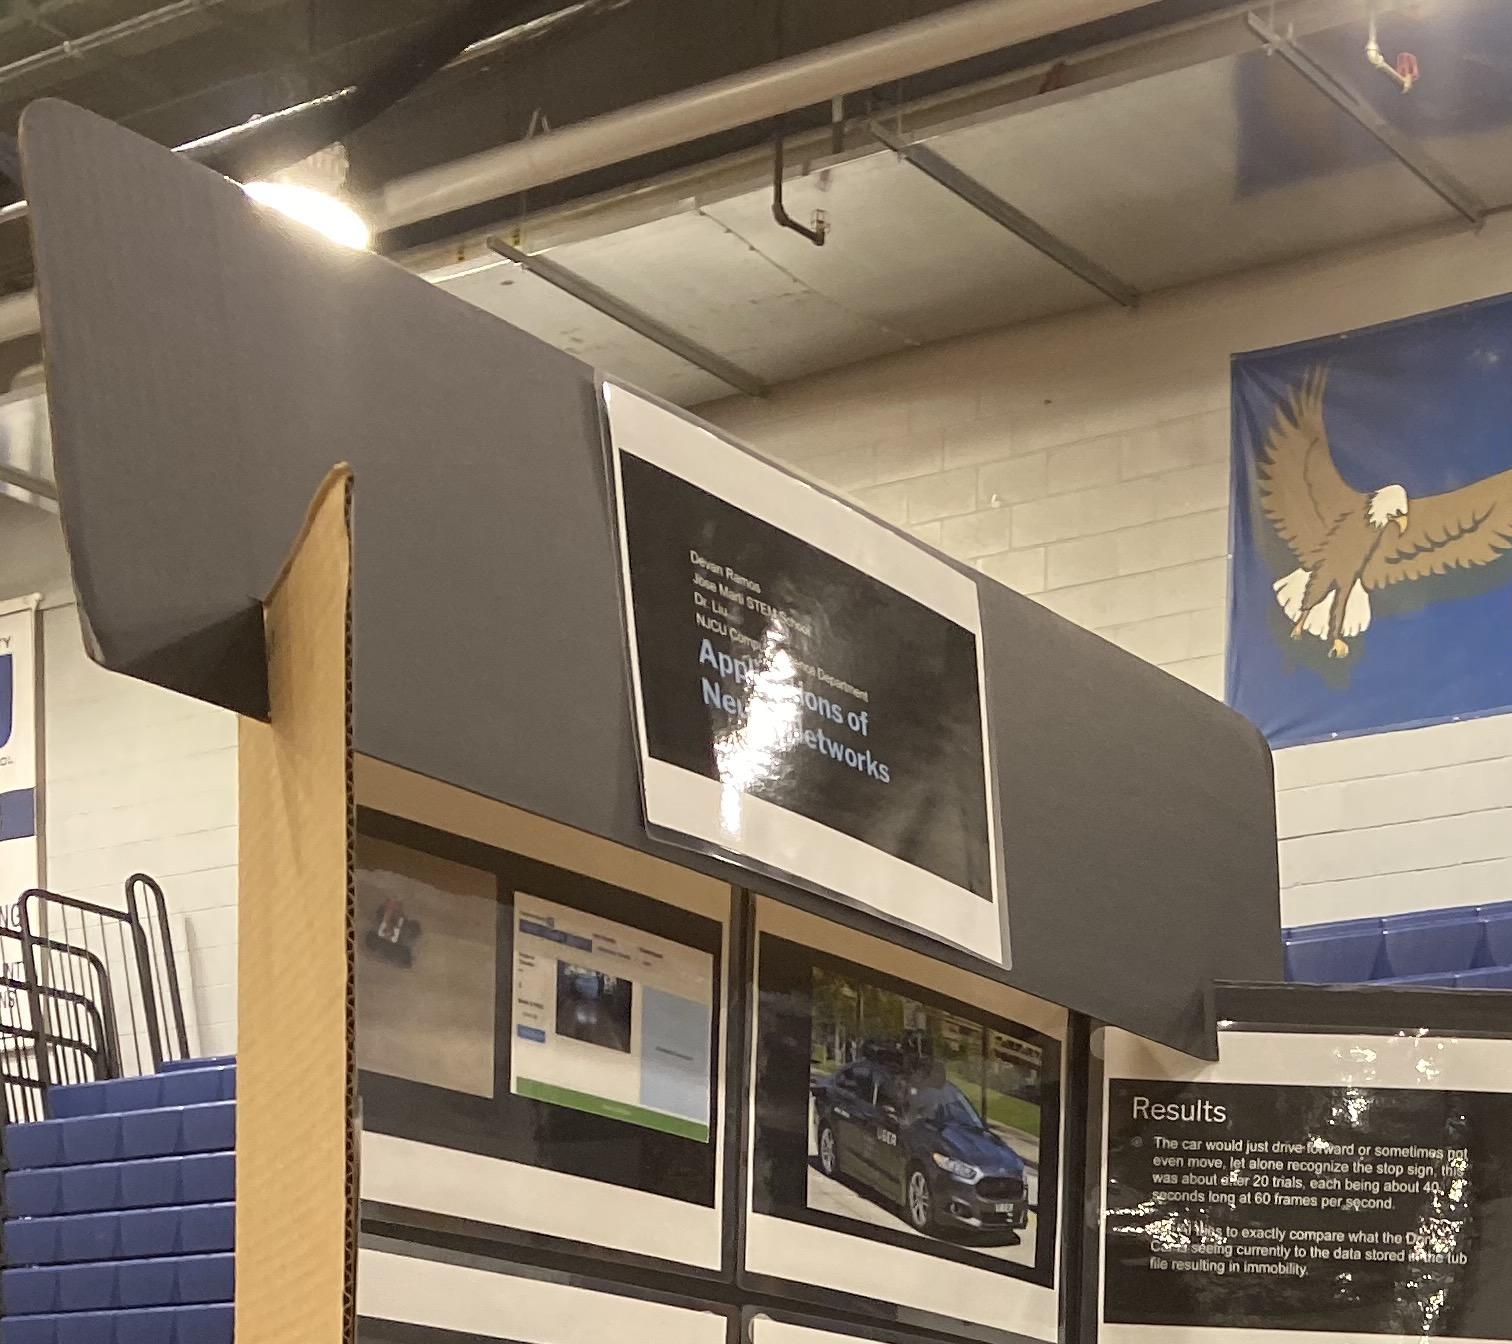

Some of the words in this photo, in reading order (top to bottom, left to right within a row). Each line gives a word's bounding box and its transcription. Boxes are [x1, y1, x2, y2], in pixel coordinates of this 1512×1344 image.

[848, 711, 869, 736] of
[797, 728, 891, 784] etworks
[1132, 1096, 1227, 1123] Results
[1152, 1155, 1184, 1167] even
[1229, 1155, 1246, 1169] let
[1351, 1160, 1373, 1174] the
[1375, 1162, 1404, 1178] stop
[1207, 1189, 1236, 1206] long
[1238, 1192, 1251, 1204] at
[1253, 1191, 1271, 1204] 60
[1320, 1196, 1342, 1210] per
[1149, 1256, 1168, 1270] file
[1227, 1259, 1240, 1272] in
